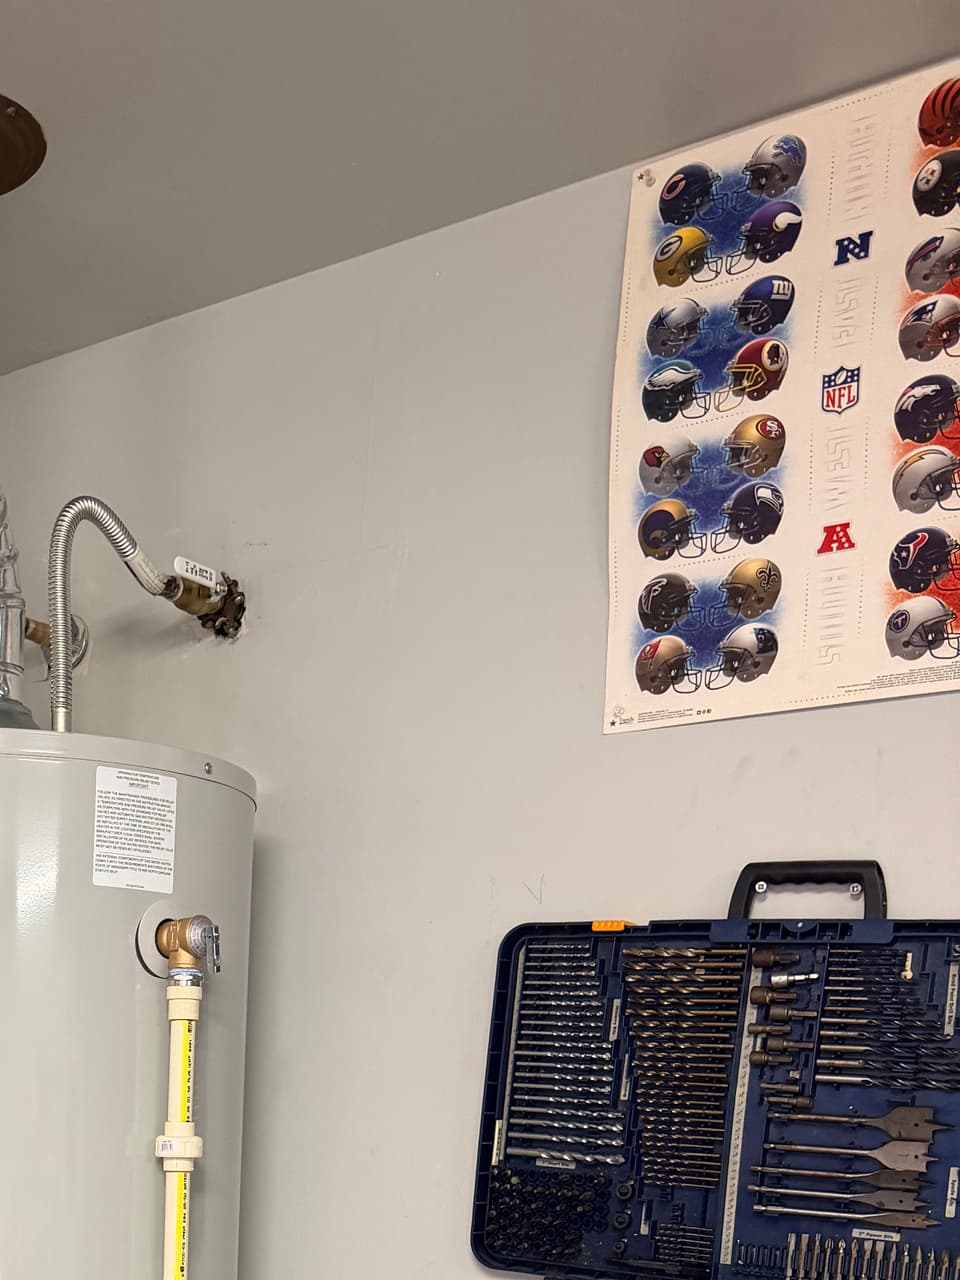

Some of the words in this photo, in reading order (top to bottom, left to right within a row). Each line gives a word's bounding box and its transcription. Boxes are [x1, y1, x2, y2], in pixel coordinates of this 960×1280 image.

[833, 229, 873, 266] N
[825, 384, 856, 409] NFL
[817, 521, 856, 555] A
